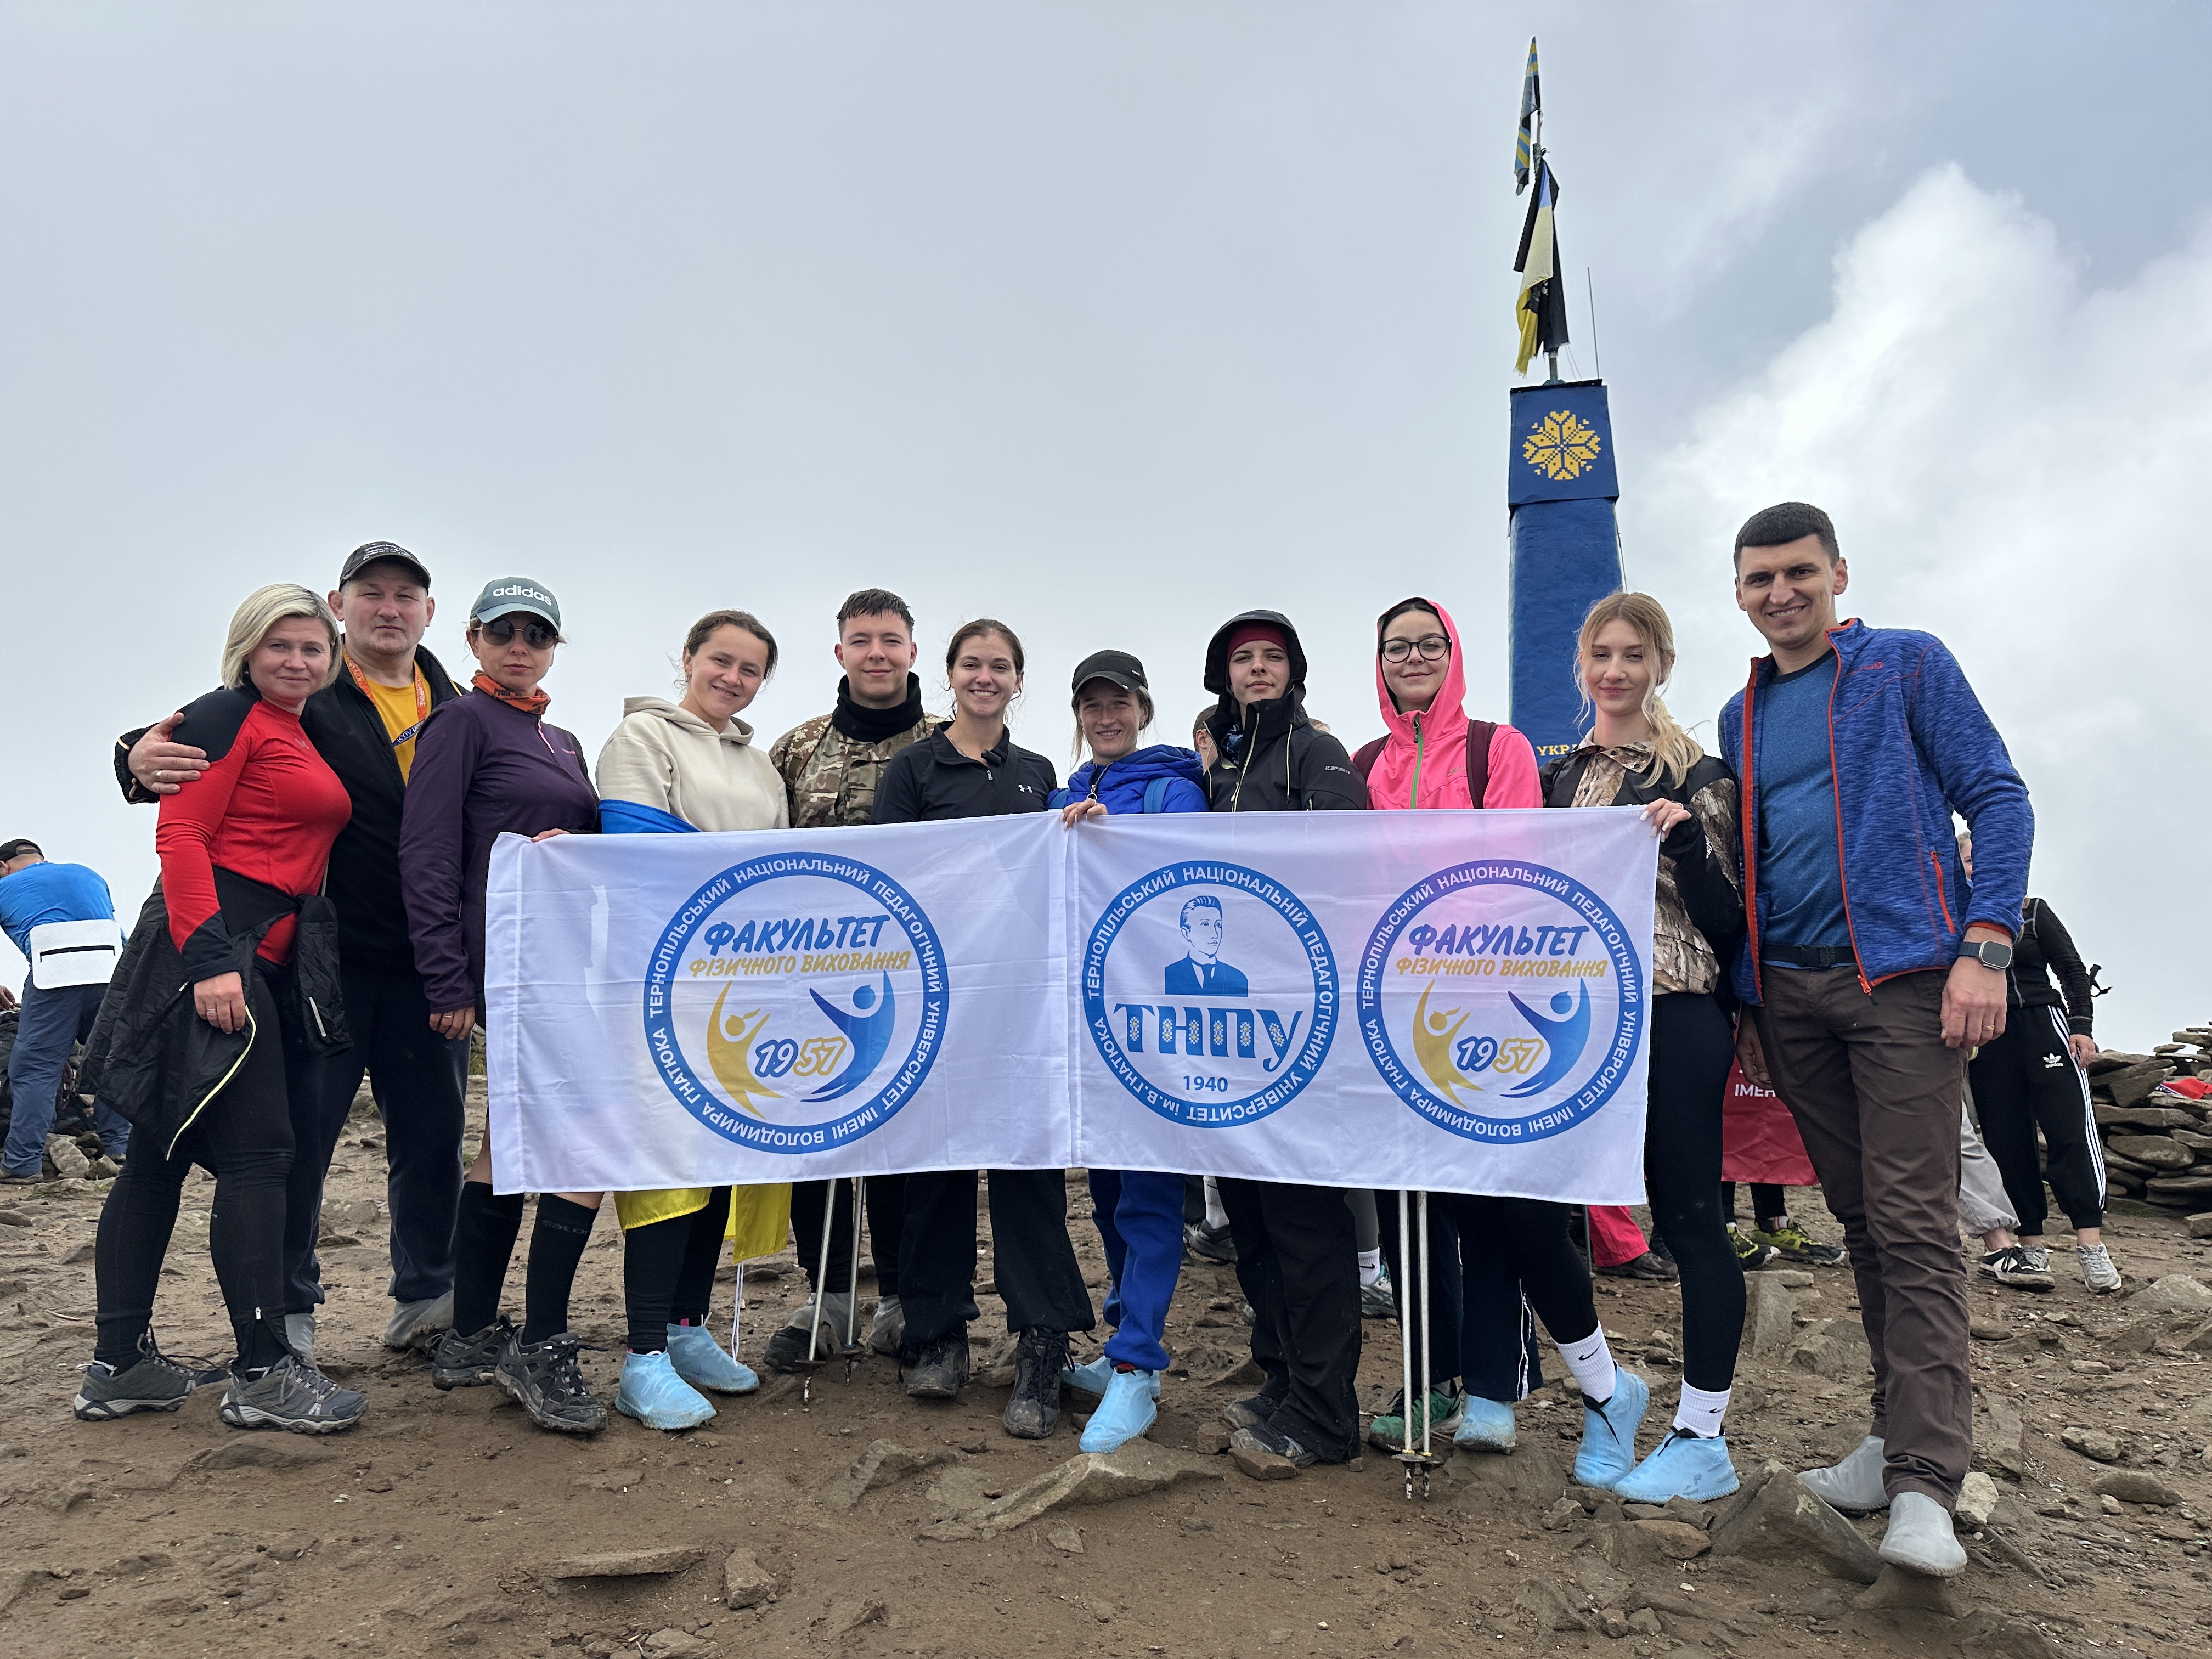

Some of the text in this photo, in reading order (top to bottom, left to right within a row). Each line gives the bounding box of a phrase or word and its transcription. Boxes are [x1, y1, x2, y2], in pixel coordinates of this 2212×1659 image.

[493, 585, 552, 606] adidas
[397, 728, 412, 743] KYIV
[1183, 866, 1308, 928] НАЦІОНАЛЬНІЙ
[704, 915, 891, 956] ФАКУЛЬТЕТ
[1087, 870, 1176, 1000] ТЕРНОПІЛЬСЬКИЙ
[1408, 923, 1590, 956] ФАКУЛЬТЕТ
[689, 950, 912, 978] ФІЗИЧНОГО ВИХОВАННЯ
[1396, 957, 1609, 978] ФІЗИЧНОГО ВИХОВАННЯ
[650, 859, 943, 1146] ТЕРНОПІЛЬСЬКИЙ НАЦІОНАЛЬНИЙ ПЕДАГОГІЧНИЙ УНІВЕРСИТЕТ ІМЕНІ ВОЛОДИМИРА ГНАТЮКА
[1300, 930, 1333, 1071] ПЕДАГОГІЧНИЙ
[1363, 866, 1638, 1137] ТЕРНОПІЛЬСЬКИЙ НАЦІОНАЛЬНИЙ ПЕДАГОГІЧНИЙ УНІВЕРСИТЕТ ІМЕНІ ВОЛОДИМИРА ГНАТЮКА
[755, 1037, 847, 1078] 1957
[1113, 1003, 1304, 1073] ТНПУ
[1456, 1036, 1544, 1074] 1957
[1183, 1075, 1228, 1092] 1940
[1187, 1071, 1304, 1122] УНІВЕРСИТЕТ
